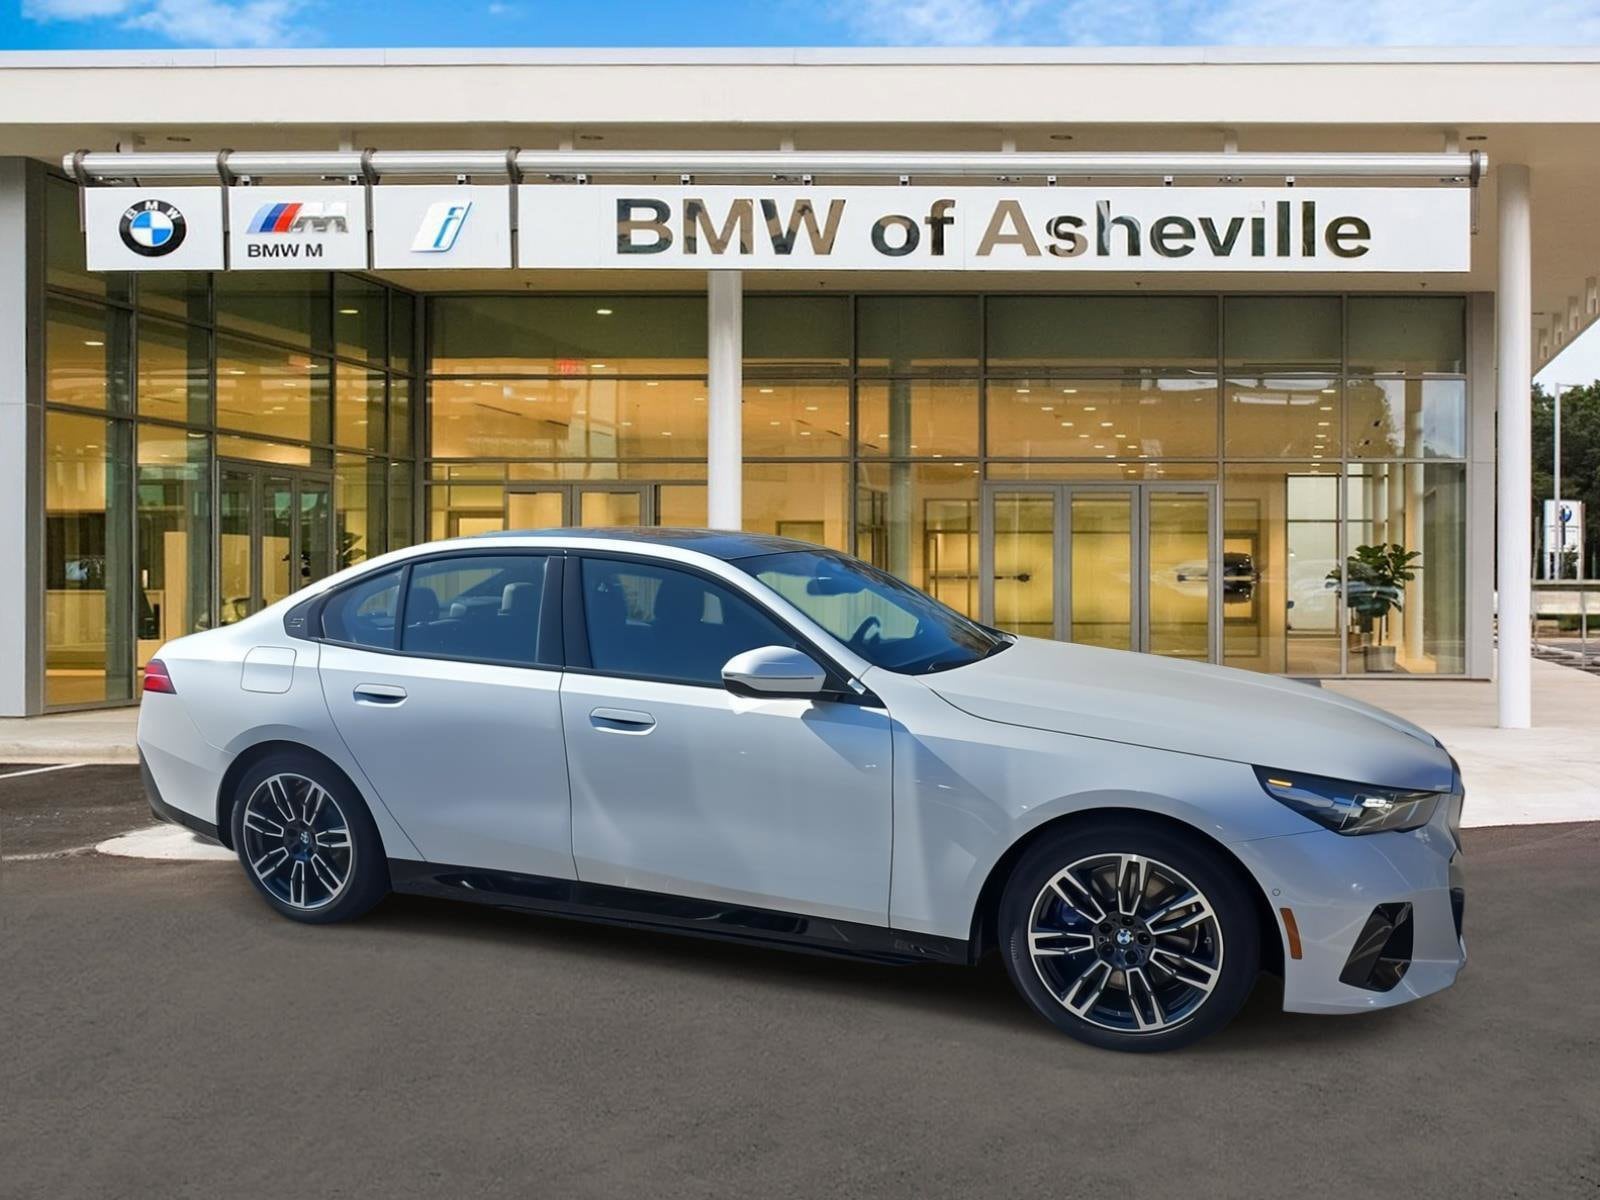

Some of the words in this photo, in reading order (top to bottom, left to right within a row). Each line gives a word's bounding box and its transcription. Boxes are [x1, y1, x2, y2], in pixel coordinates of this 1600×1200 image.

[124, 200, 180, 220] BMW
[616, 198, 846, 255] BMW
[871, 199, 956, 256] of
[975, 199, 1371, 257] Asheville
[247, 243, 299, 257] BMW
[305, 243, 323, 257] M
